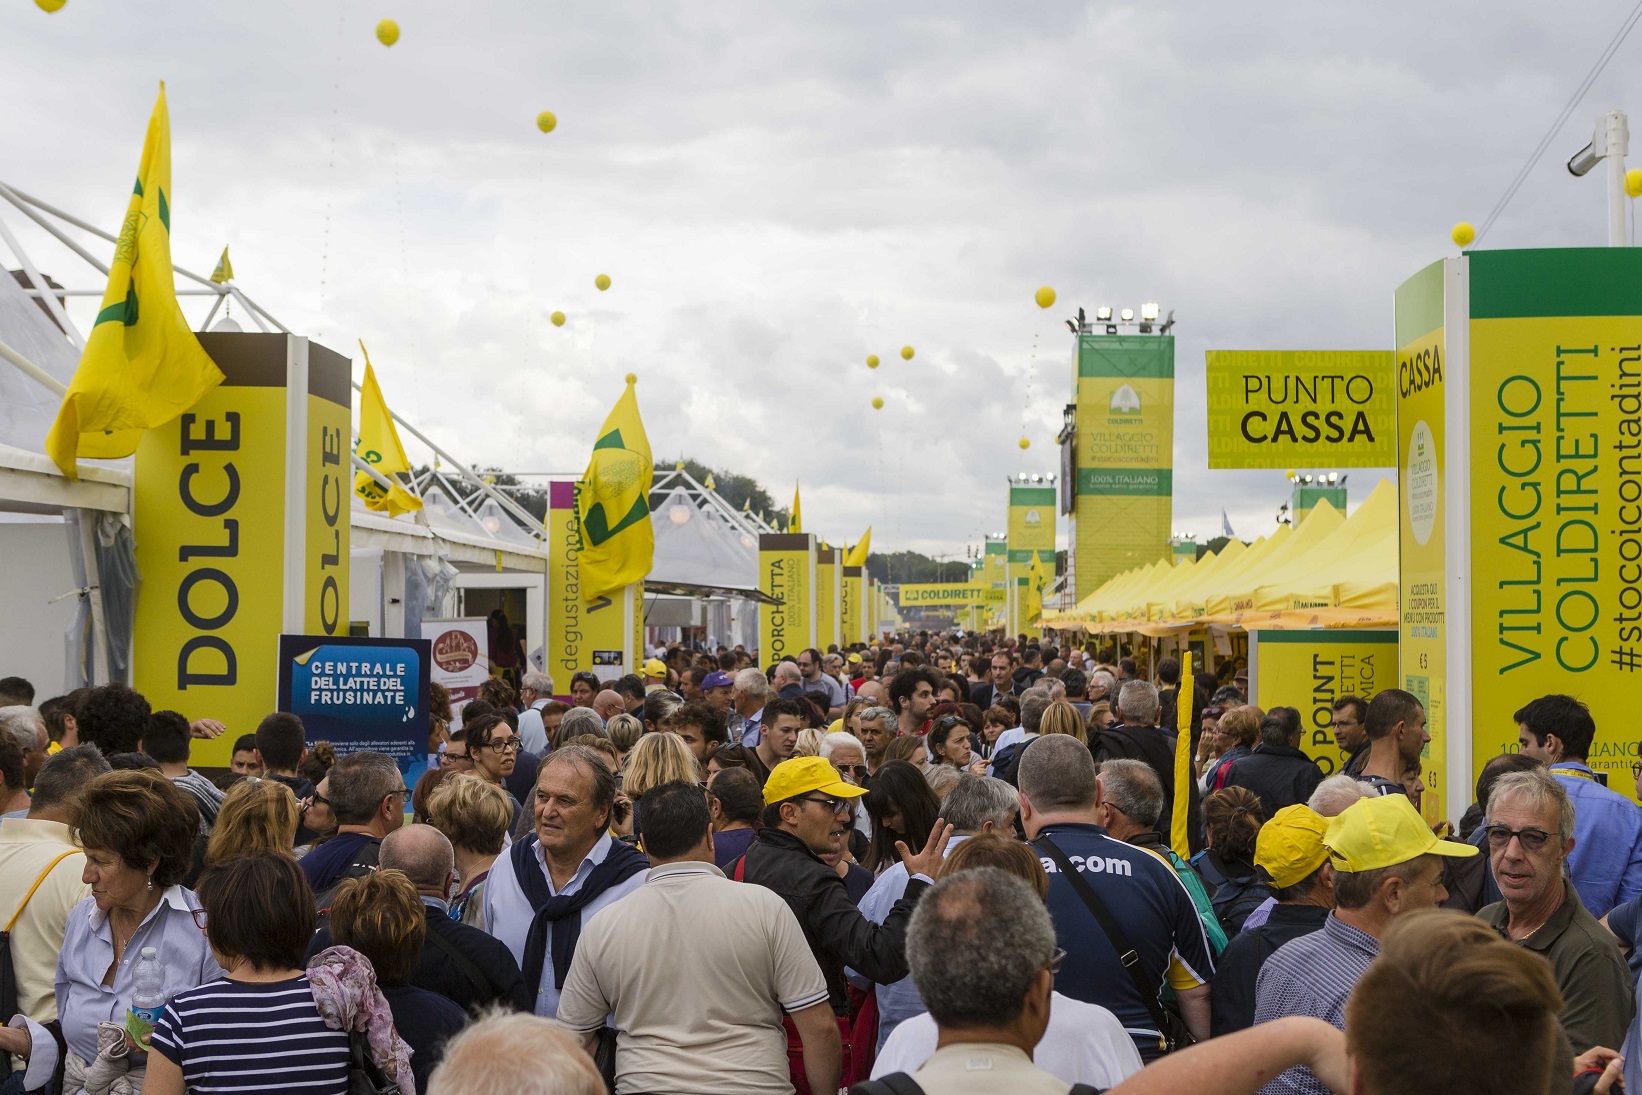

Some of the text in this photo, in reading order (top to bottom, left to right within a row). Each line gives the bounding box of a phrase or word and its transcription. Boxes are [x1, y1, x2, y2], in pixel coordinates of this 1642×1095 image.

[1399, 344, 1442, 399] CASSA
[1242, 375, 1374, 405] PUNTO
[1090, 432, 1153, 442] VILLAGGIO
[1240, 410, 1375, 444] CASSA
[1091, 443, 1159, 454] COLDIRETTI
[1090, 475, 1158, 484] 100% ITALIANO
[1497, 374, 1542, 675] VILLAGGIO
[1555, 344, 1600, 673] COLDIRETTI
[1610, 343, 1642, 673] #stocoicontadini
[320, 425, 341, 636] OLCE
[177, 411, 241, 691] DOLCE
[561, 520, 583, 671] degustazione
[921, 589, 982, 600] COLDIRETT
[311, 661, 406, 676] CENTRALE
[311, 677, 405, 690] DEL LATTE DEL
[310, 691, 405, 705] FRUSINATE
[1312, 653, 1335, 746] POINT
